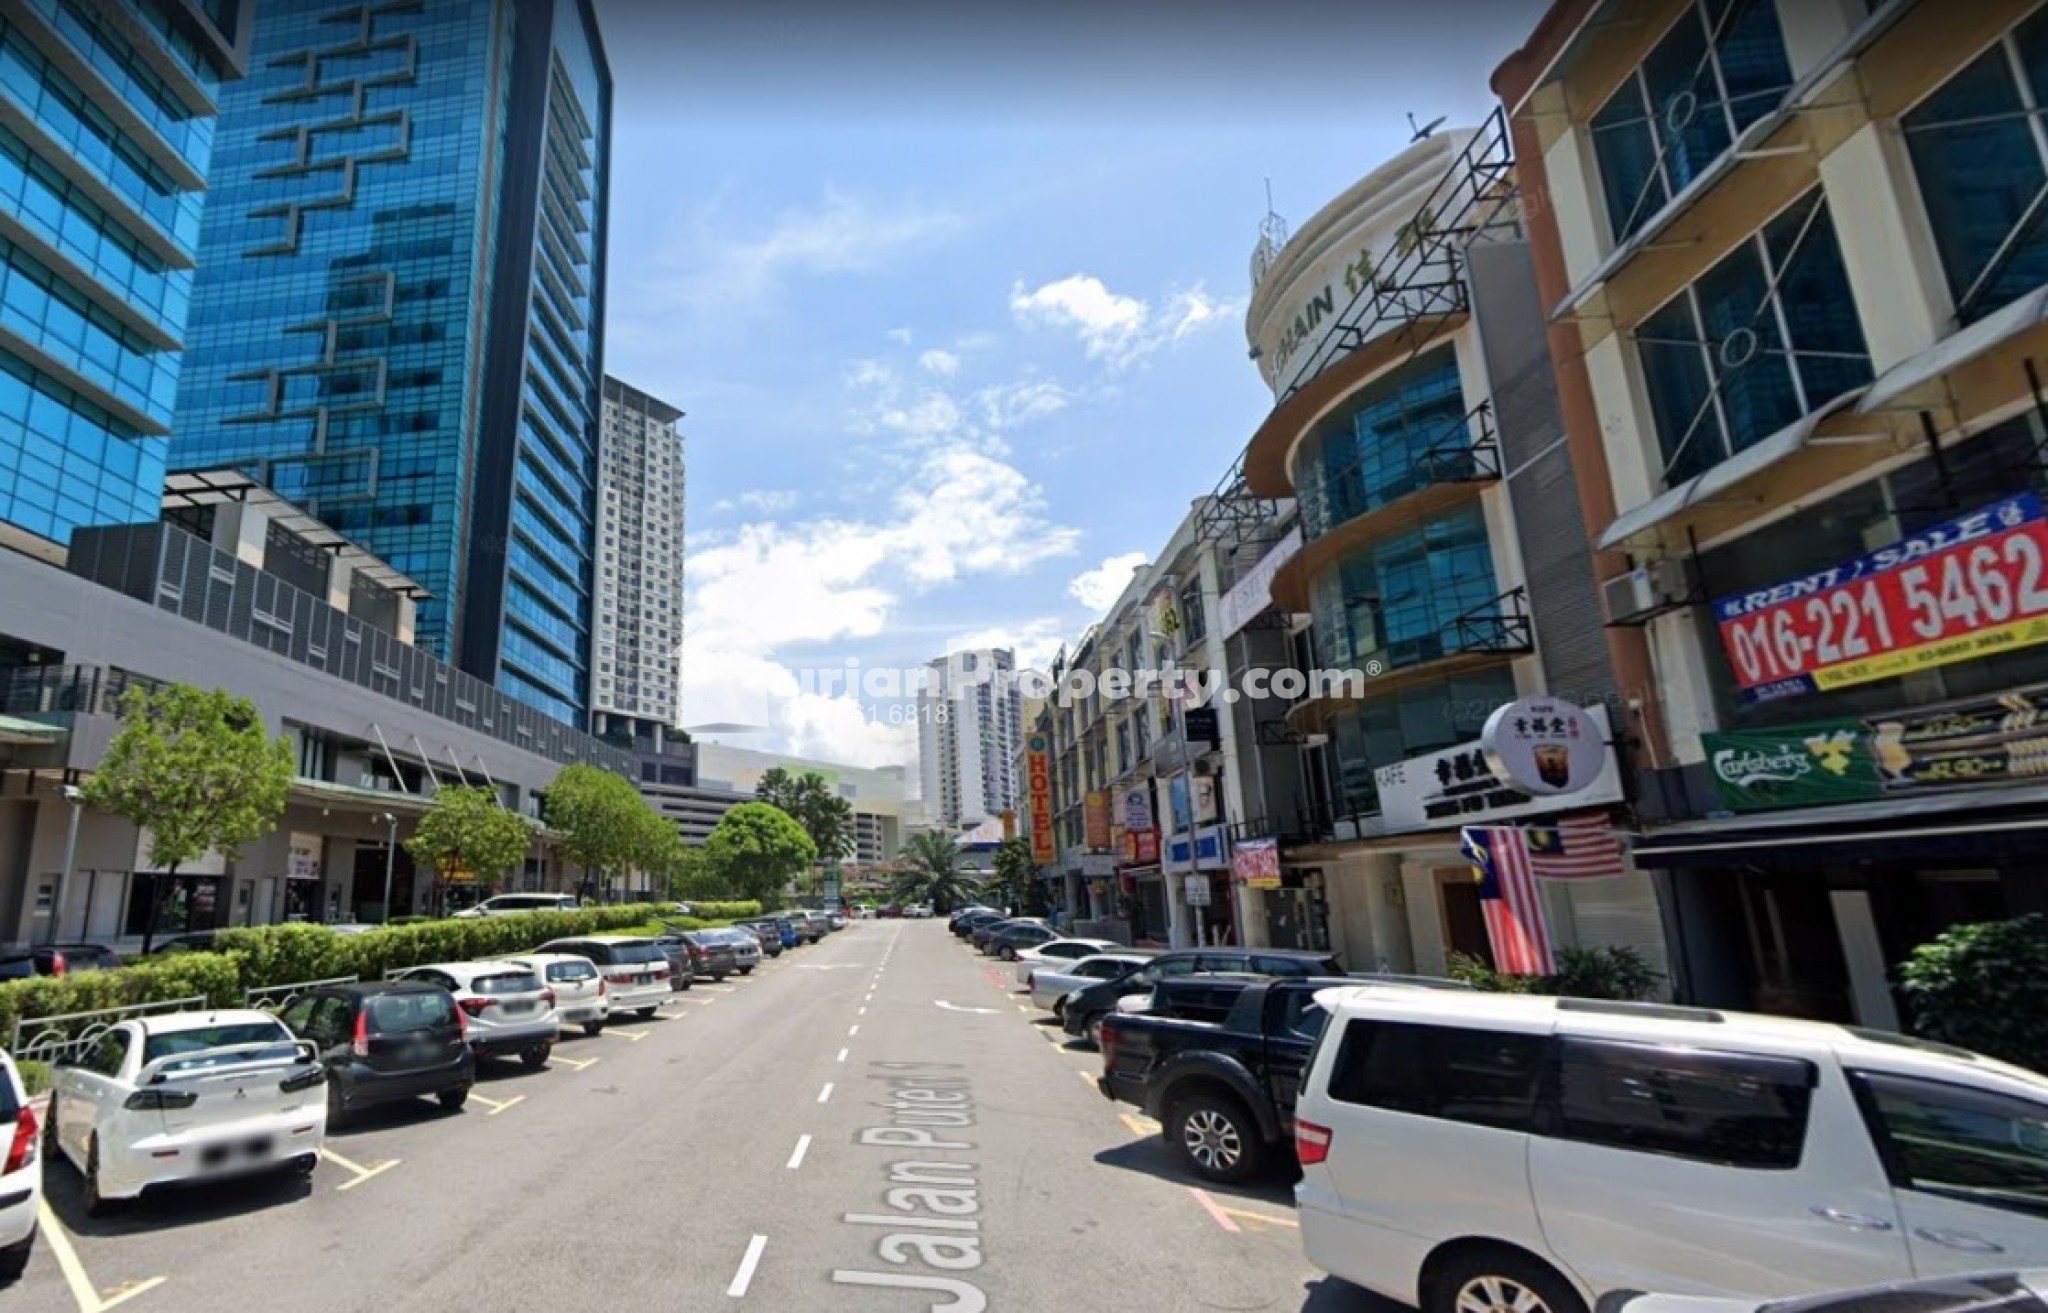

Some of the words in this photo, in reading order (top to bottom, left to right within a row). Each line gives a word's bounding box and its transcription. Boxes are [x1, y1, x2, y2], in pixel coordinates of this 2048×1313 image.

[1732, 578, 1894, 682] 016-221
[1902, 532, 2048, 640] 5462
[1743, 567, 1842, 614] RENT
[1873, 511, 1992, 572] SALE
[1029, 754, 1052, 850] HOTEL
[1714, 743, 1812, 787] Carlsberg
